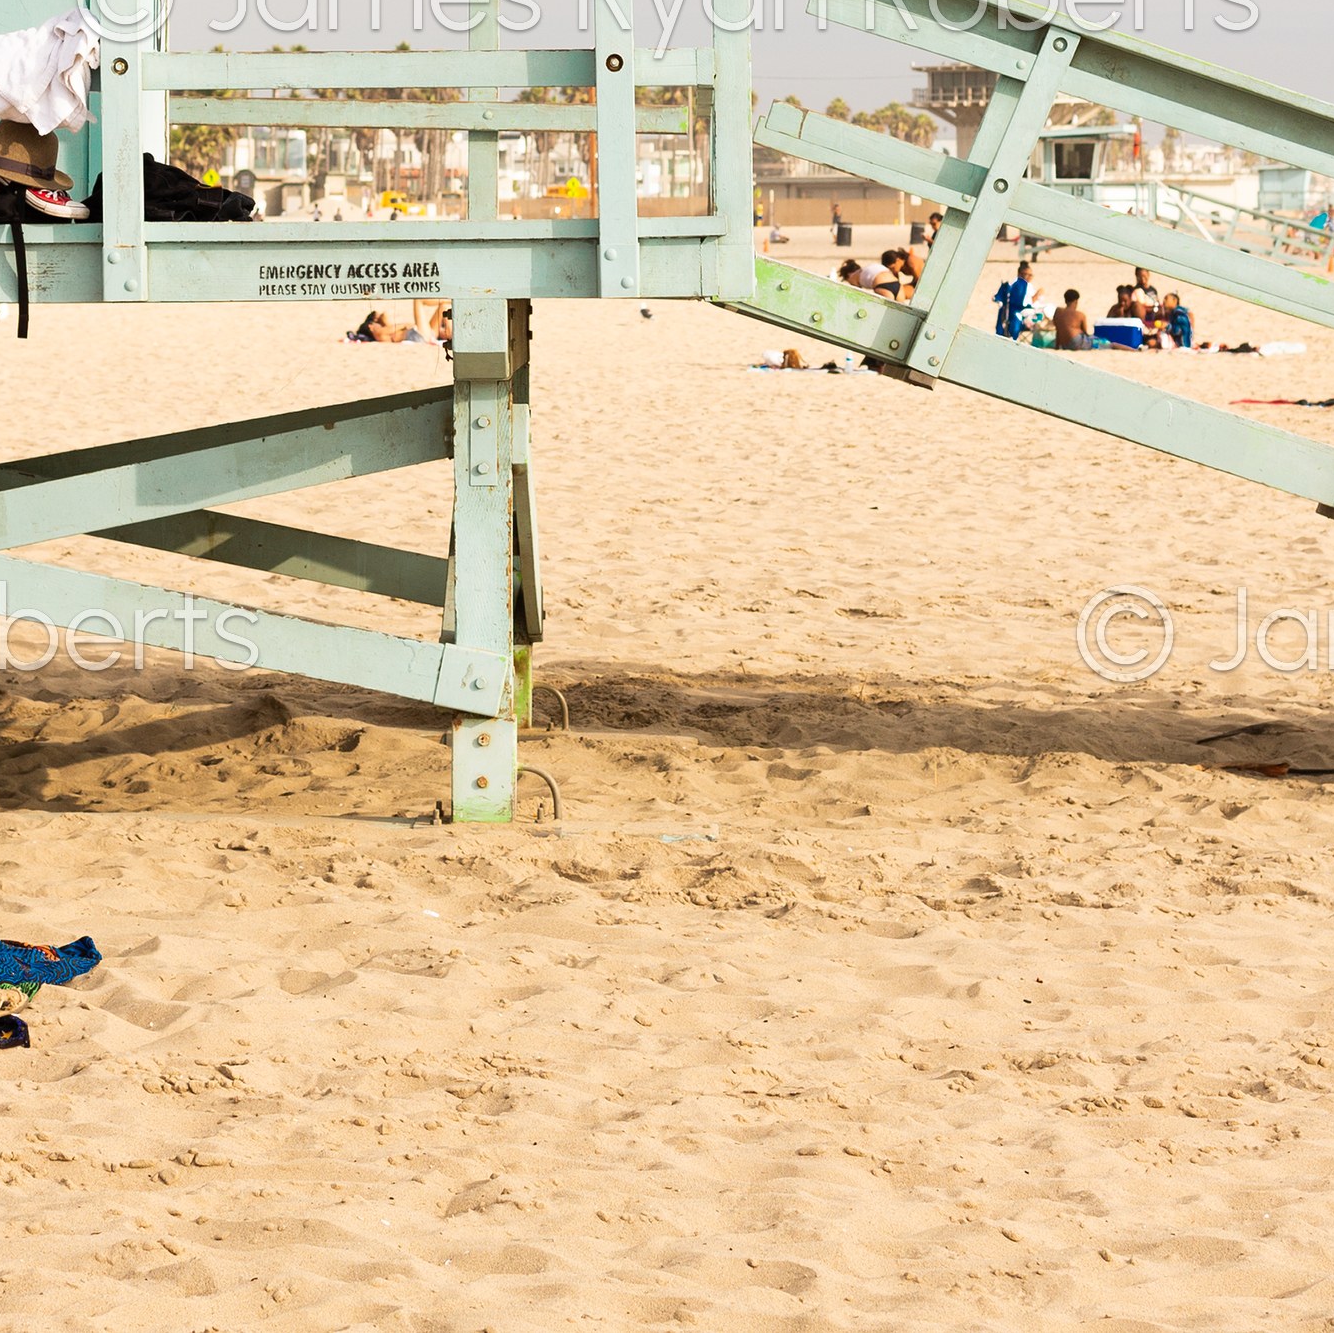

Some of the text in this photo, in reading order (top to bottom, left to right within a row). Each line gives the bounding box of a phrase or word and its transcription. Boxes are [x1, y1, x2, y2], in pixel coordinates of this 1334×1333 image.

[259, 262, 440, 279] EMERGENCY ACCESS AREA
[259, 281, 441, 296] PLEASE STAY OUTSIDE THE CONES
